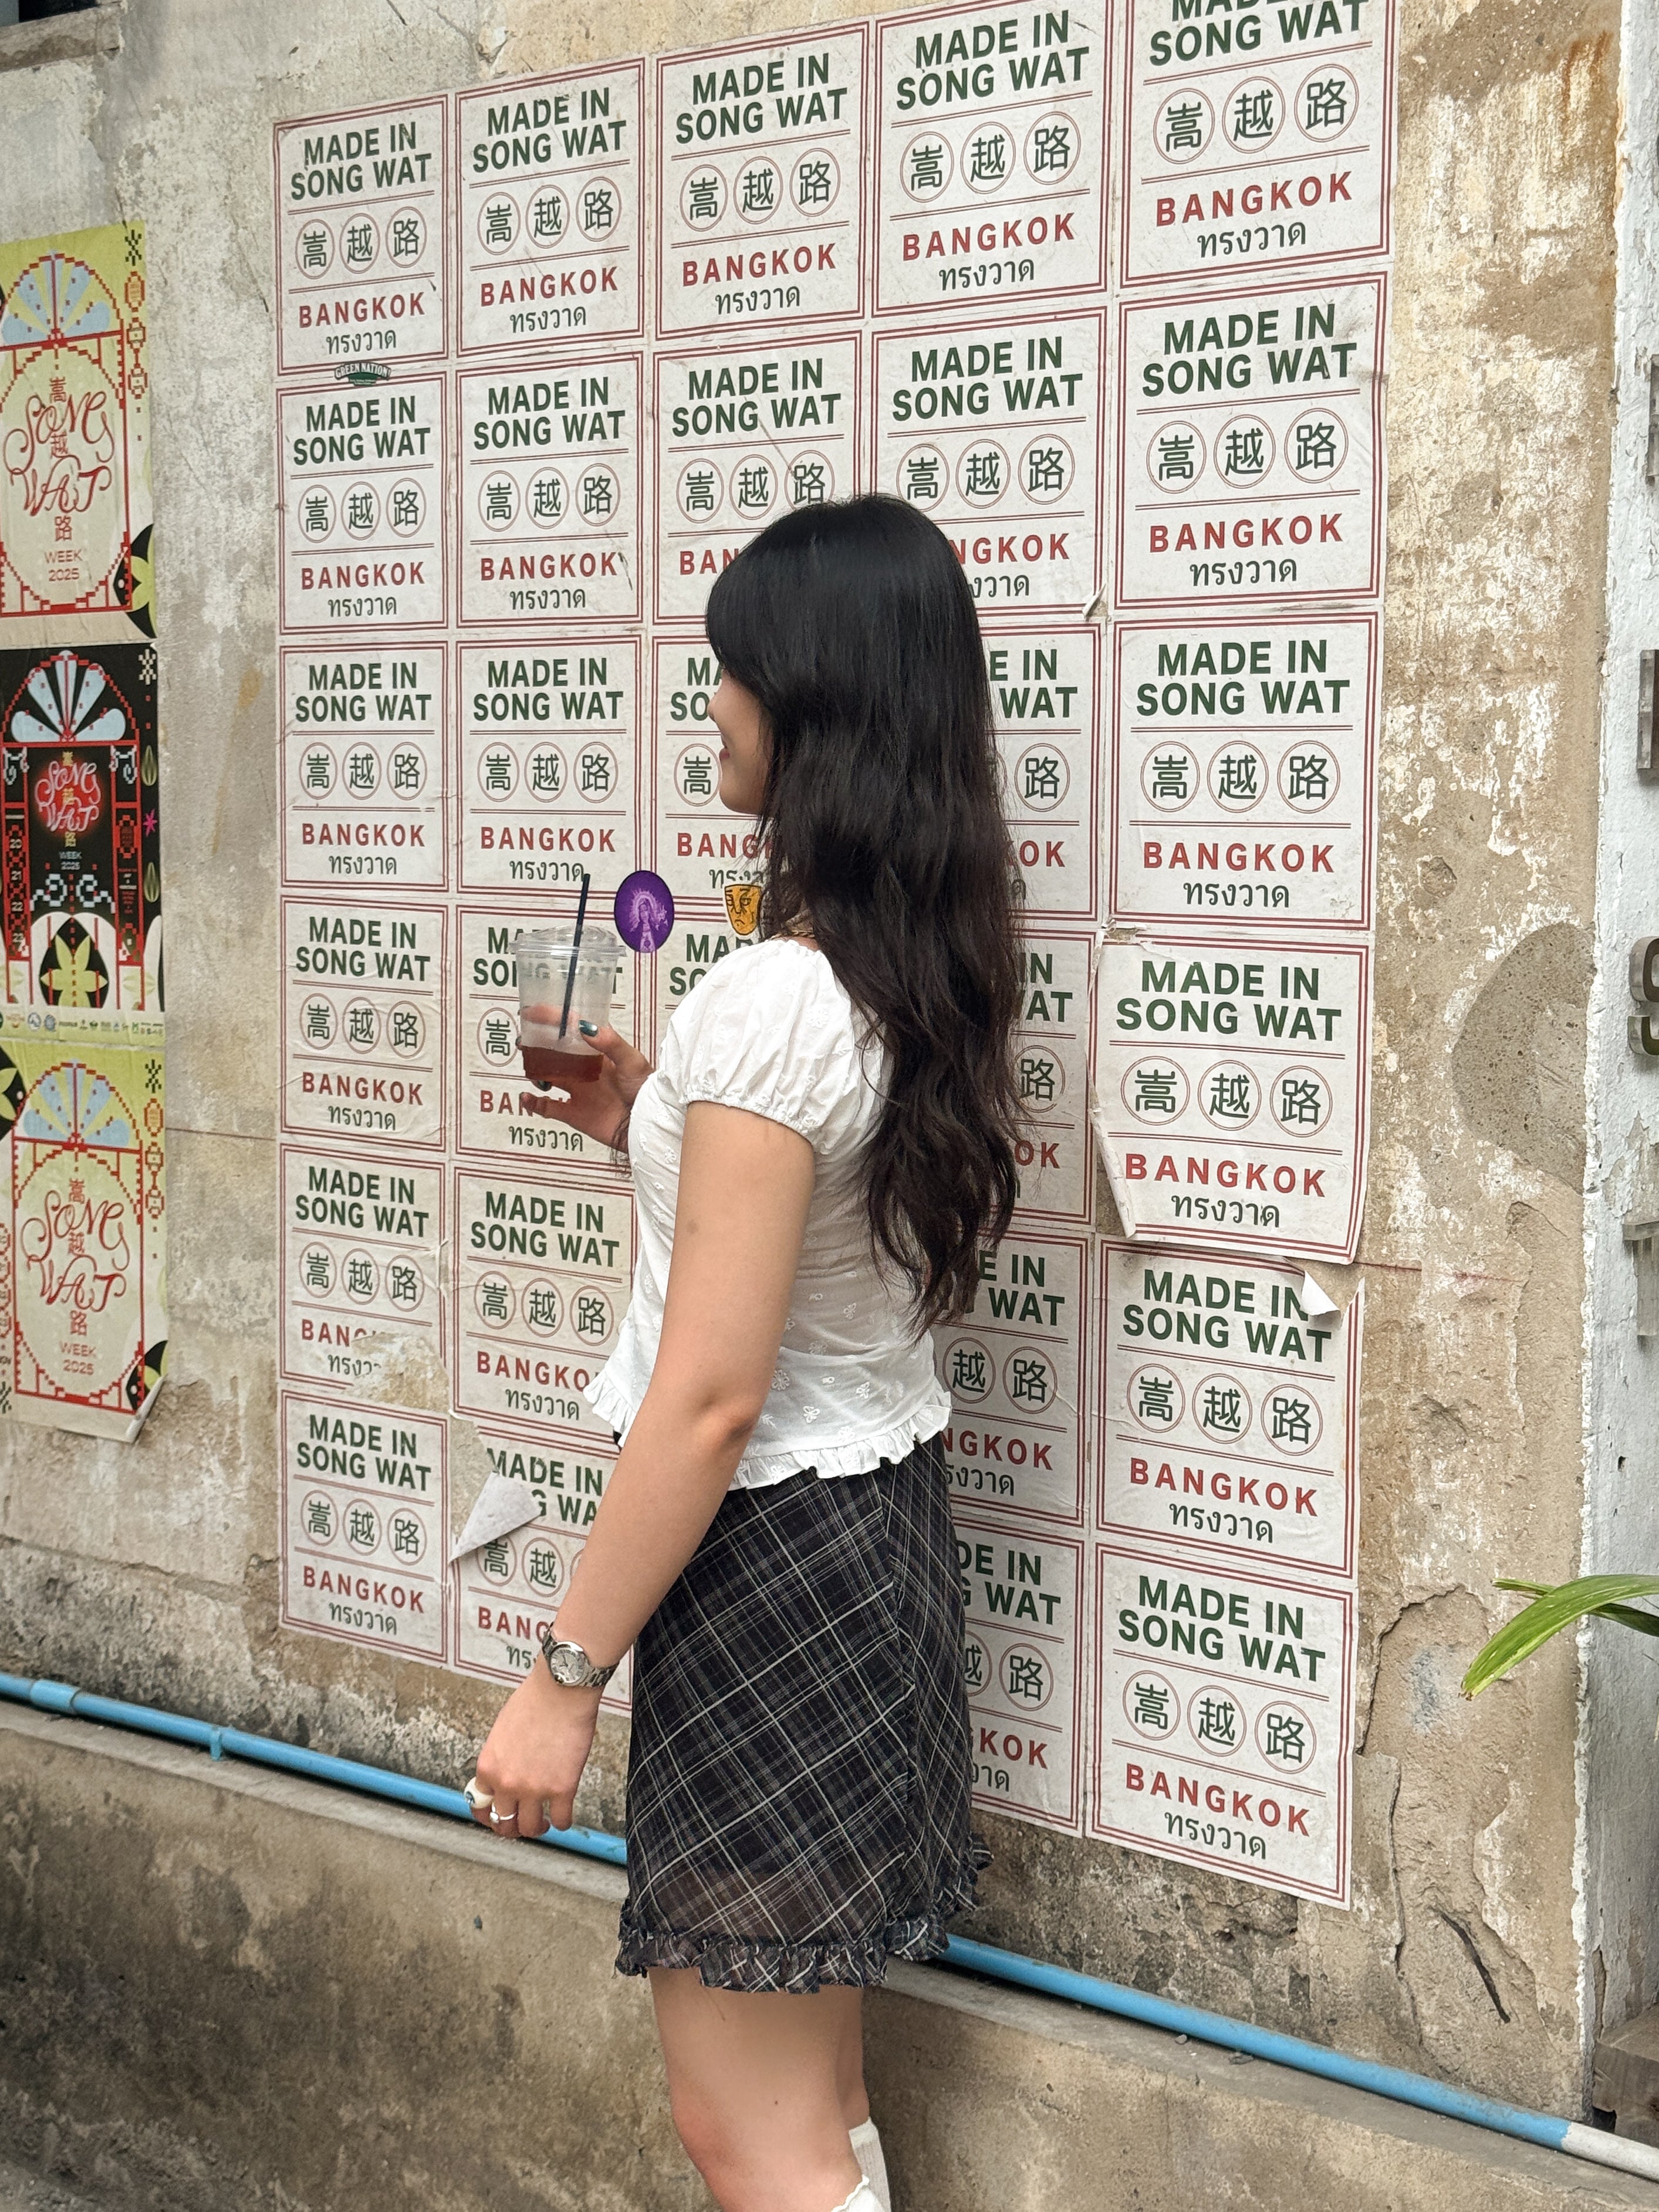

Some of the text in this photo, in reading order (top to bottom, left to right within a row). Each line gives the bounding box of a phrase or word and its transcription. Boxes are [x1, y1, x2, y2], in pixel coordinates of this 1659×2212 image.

[916, 10, 1068, 69] MADE IN
[1150, 15, 1261, 66] SONG
[1278, 0, 1369, 43] WAT
[693, 53, 829, 105] MADE IN
[897, 46, 1089, 110] SONG WAT
[488, 87, 609, 136] MADE IN
[676, 87, 847, 144] SONG WAT
[305, 121, 415, 166] MADE IN
[473, 120, 626, 173] SONG WAT
[292, 153, 431, 200] SONG WAT
[1157, 171, 1351, 227] BANGKOK
[903, 212, 1074, 261] BANGKOK
[1197, 222, 1305, 258] ทรงวาด
[683, 243, 835, 286] BANGKOK
[939, 259, 1033, 291] ทรงวาด
[481, 266, 617, 306] BANGKOK
[715, 286, 799, 315] ทรงวาด
[300, 292, 424, 328] BANGKOK
[510, 307, 586, 333] ทรงวาด
[1164, 303, 1334, 355] MADE IN
[326, 330, 396, 354] ทรงวาด
[912, 336, 1062, 382] MADE IN
[689, 359, 822, 400] MADE IN
[1143, 343, 1357, 397] SONG WAT
[306, 396, 415, 432] MADE IN
[489, 377, 608, 415] MADE IN
[673, 393, 841, 437] SONG WAT
[893, 373, 1083, 421] SONG WAT
[3, 391, 115, 475] SONG
[294, 427, 430, 465] SONG WAT
[474, 410, 625, 450] SONG WAT
[949, 533, 1070, 565] NGKOK
[1150, 514, 1343, 552] BANGKOK
[45, 549, 82, 563] WEEK
[49, 568, 80, 582] 2025
[481, 552, 617, 580] BANGKOK
[1190, 559, 1296, 586] ทรงวาด
[302, 562, 424, 590] BANGKOK
[328, 597, 396, 617] ทรงวาด
[510, 589, 585, 610] ทรงวาด
[309, 662, 416, 690] MADE IN
[488, 658, 606, 687] MADE IN
[1023, 649, 1057, 681] IN
[1158, 640, 1326, 676] MADE IN
[296, 694, 431, 722] SONG WAT
[474, 691, 623, 721] SONG WAT
[999, 687, 1078, 718] WAT
[1137, 680, 1350, 716] SONG WAT
[302, 823, 424, 846] BANGKOK
[481, 827, 615, 852] BANGKOK
[329, 856, 396, 874] ทรงวาด
[509, 860, 585, 882] ทรงวาด
[1144, 842, 1333, 873] BANGKOK
[1184, 883, 1289, 907] ทรงวาด
[309, 917, 415, 949] MADE IN
[296, 947, 430, 981] SONG WAT
[1142, 961, 1319, 1000] MADE IN
[1116, 998, 1342, 1041] SONG WAT
[302, 1072, 423, 1105] BANGKOK
[328, 1106, 395, 1130] ทรงวาด
[509, 1126, 583, 1152] ทรงวาด
[309, 1166, 414, 1204] MADE IN
[1126, 1153, 1325, 1197] BANGKOK
[20, 1190, 130, 1271] SONG
[296, 1195, 429, 1237] SONG WAT
[486, 1191, 603, 1232] MADE IN
[1171, 1196, 1279, 1227] ทรงวาด
[471, 1222, 619, 1267] SONG WAT
[1012, 1254, 1045, 1288] IN
[988, 1287, 1065, 1326] WAT
[1144, 1269, 1308, 1322] MADE IN
[60, 1340, 96, 1357] WEEK
[1123, 1305, 1332, 1362] SONG WAT
[63, 1359, 94, 1376] 2025
[478, 1350, 590, 1393] BANGKO
[505, 1389, 579, 1420] ทรงวาด
[310, 1414, 416, 1458] MADE IN
[298, 1443, 431, 1491] SONG WAT
[576, 1465, 603, 1497] IN
[1131, 1457, 1317, 1517] BANGKOK
[1170, 1504, 1272, 1543] ทรงวาด
[1008, 1550, 1042, 1586] IN
[304, 1566, 423, 1613] BANGKOK
[984, 1581, 1061, 1625] WAT
[1140, 1575, 1303, 1639] MADE IN
[329, 1603, 397, 1634] ทรงวาด
[1119, 1609, 1326, 1681] SONG WAT
[1126, 1763, 1309, 1836] BANGKOK
[1164, 1812, 1265, 1859] ทรงวาด
